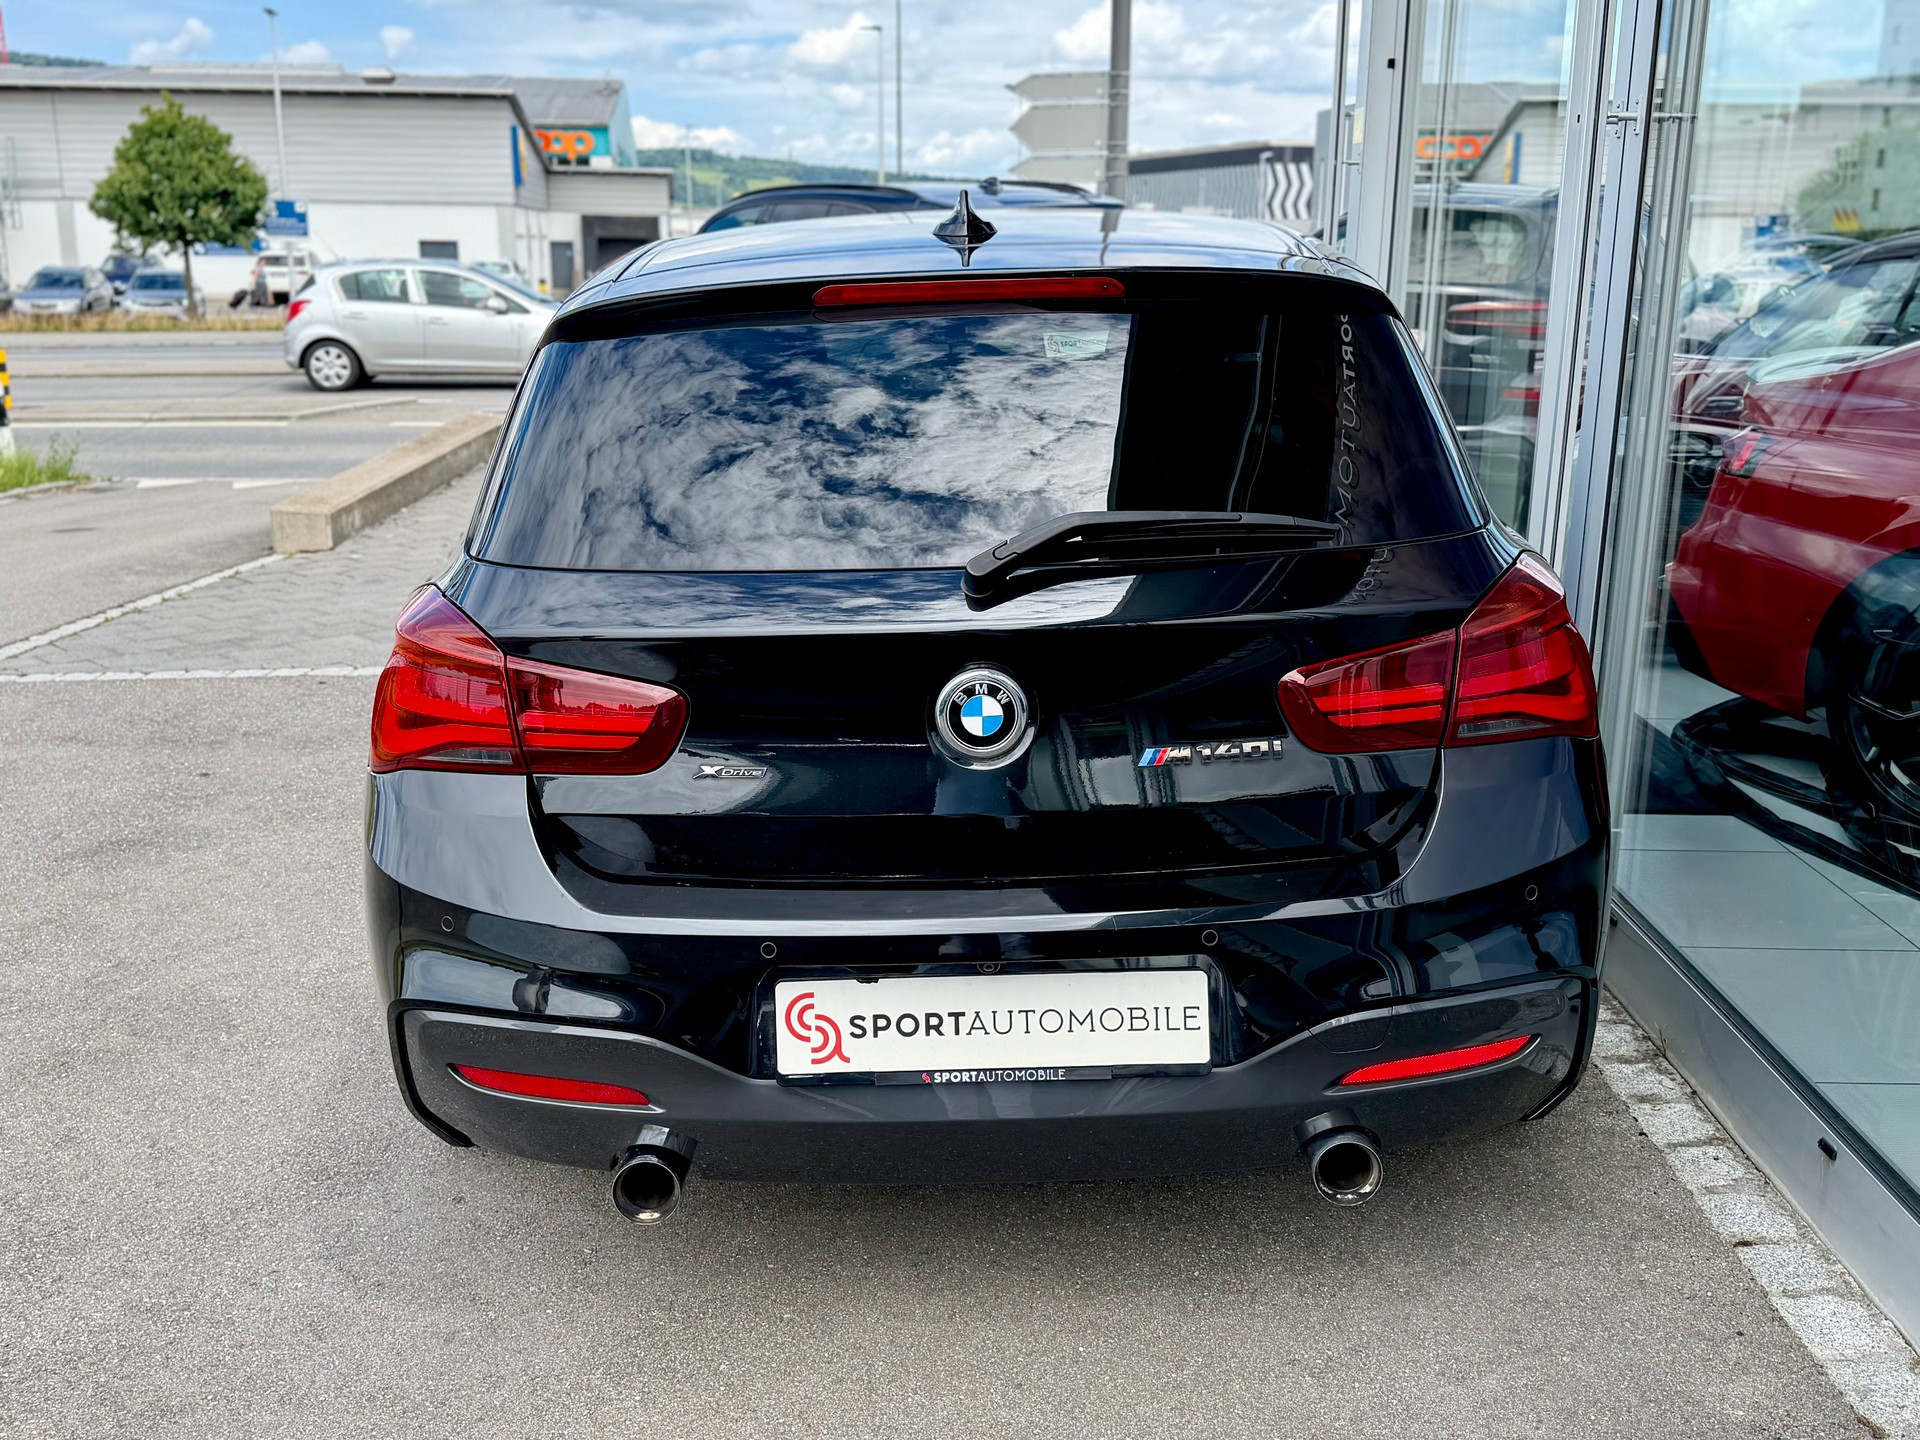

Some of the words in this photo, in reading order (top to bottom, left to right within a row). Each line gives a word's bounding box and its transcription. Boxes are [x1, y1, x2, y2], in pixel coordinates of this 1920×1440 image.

[953, 683, 1011, 706] BMW
[850, 1006, 1201, 1039] SPORTAUTOMOBILE
[934, 1069, 1066, 1083] SPORTAUTOMOBILE
